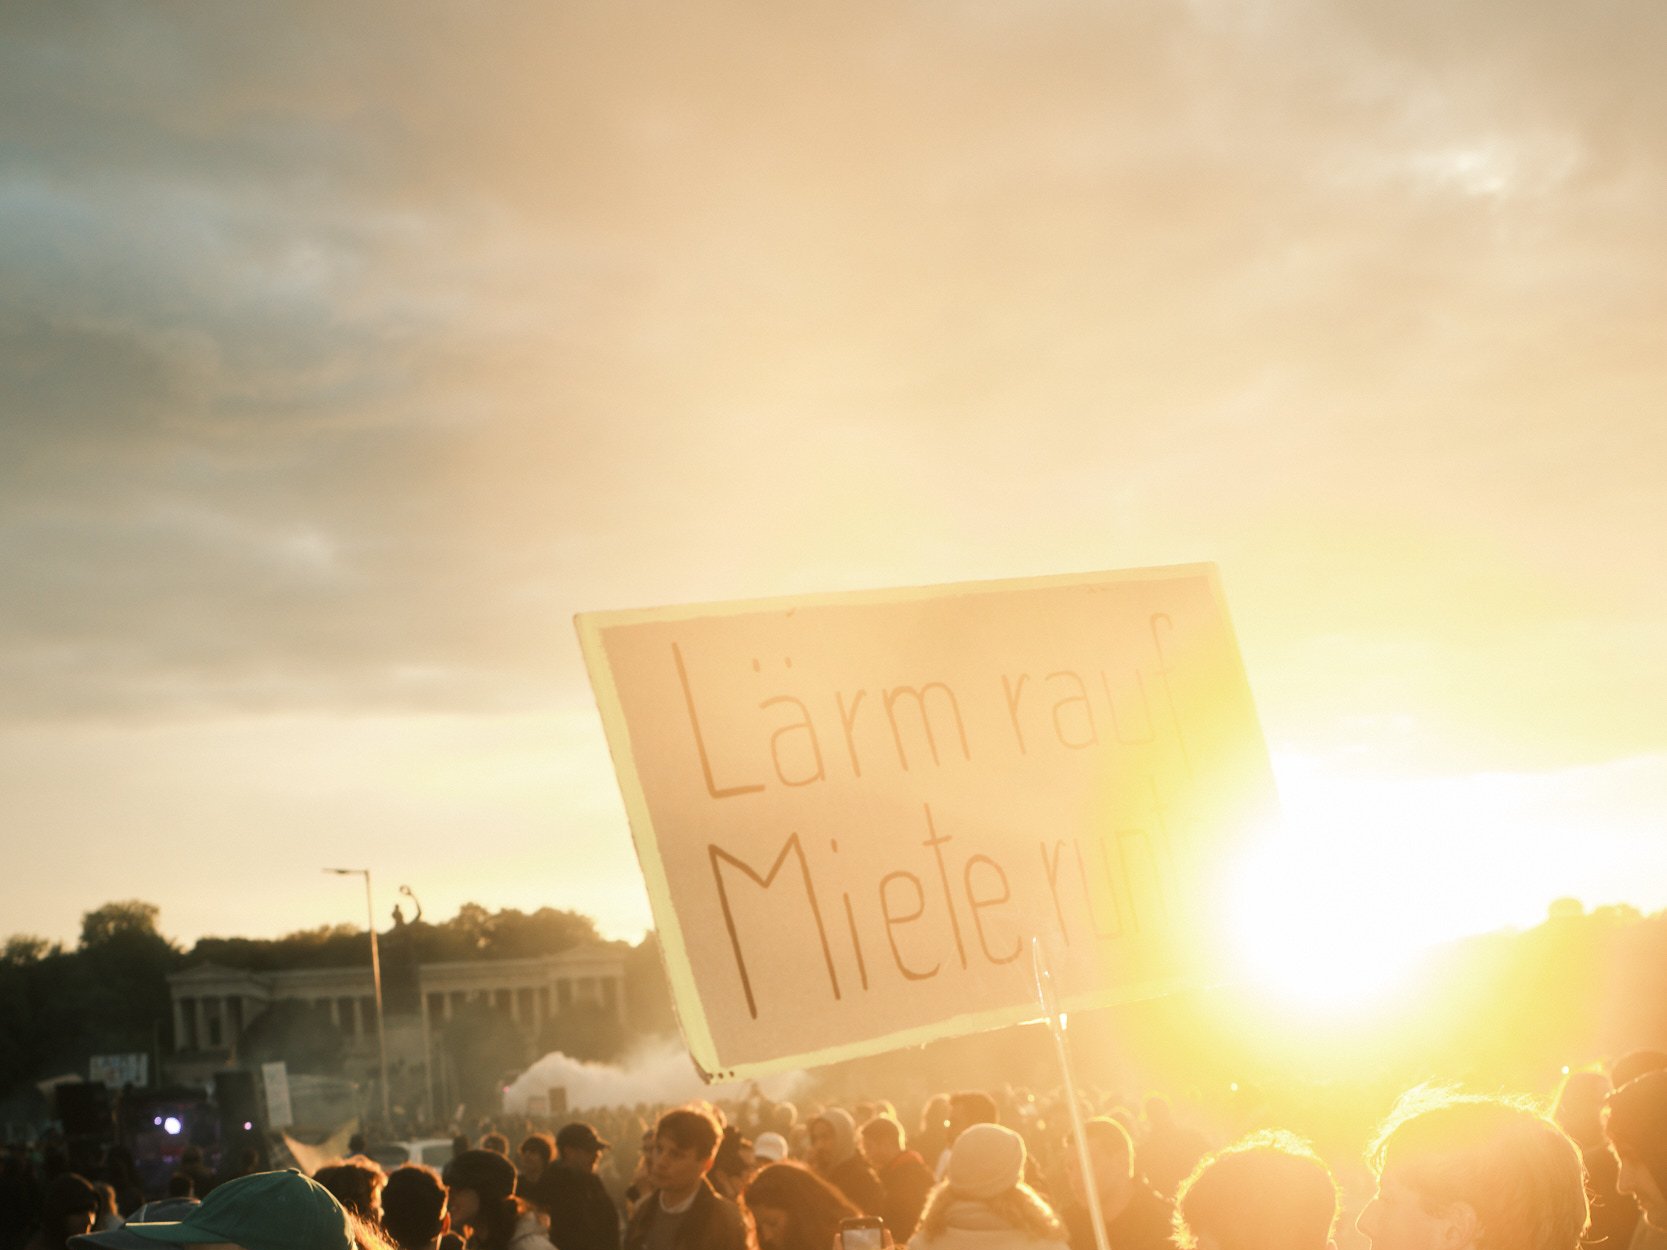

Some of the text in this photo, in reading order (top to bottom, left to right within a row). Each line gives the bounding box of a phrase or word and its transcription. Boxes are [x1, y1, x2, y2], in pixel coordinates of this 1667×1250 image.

[671, 612, 1194, 798] Lärm rauf
[707, 802, 1023, 1020] Miete
